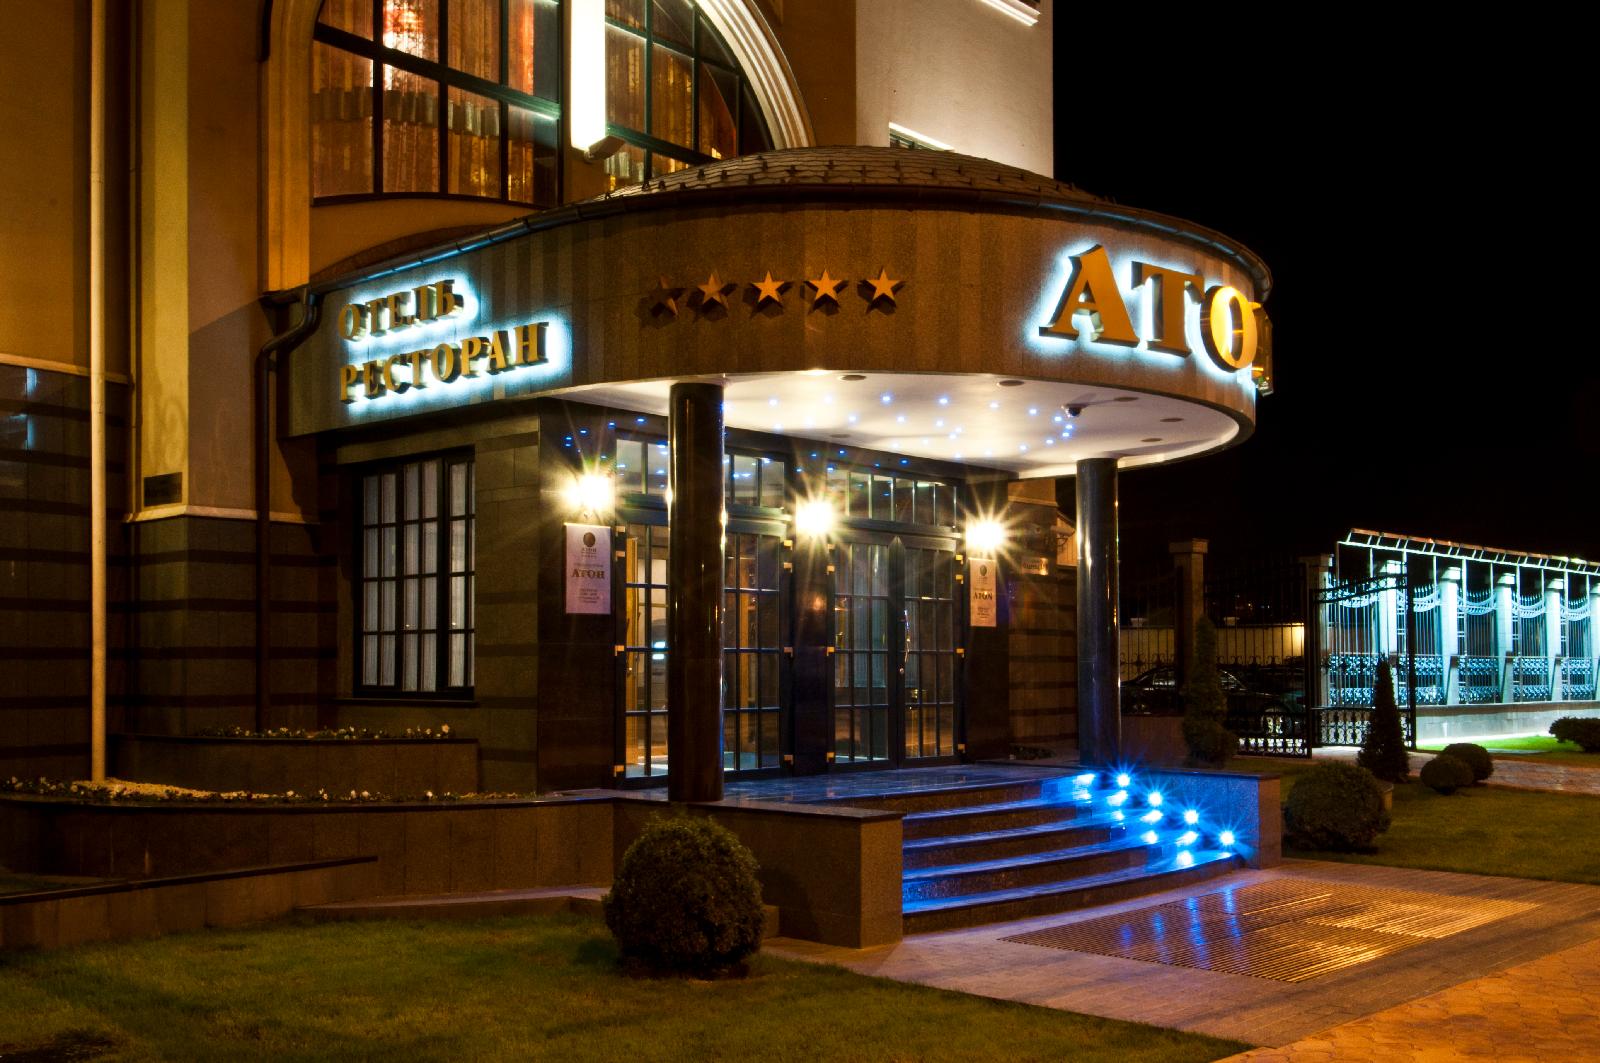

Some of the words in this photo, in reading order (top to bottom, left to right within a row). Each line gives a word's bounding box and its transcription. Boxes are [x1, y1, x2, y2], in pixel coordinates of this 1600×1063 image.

[338, 280, 464, 342] ОТЕЛЬ
[1039, 244, 1273, 395] АТО
[340, 322, 549, 404] РЕСТОРАН
[571, 568, 605, 579] АТОН
